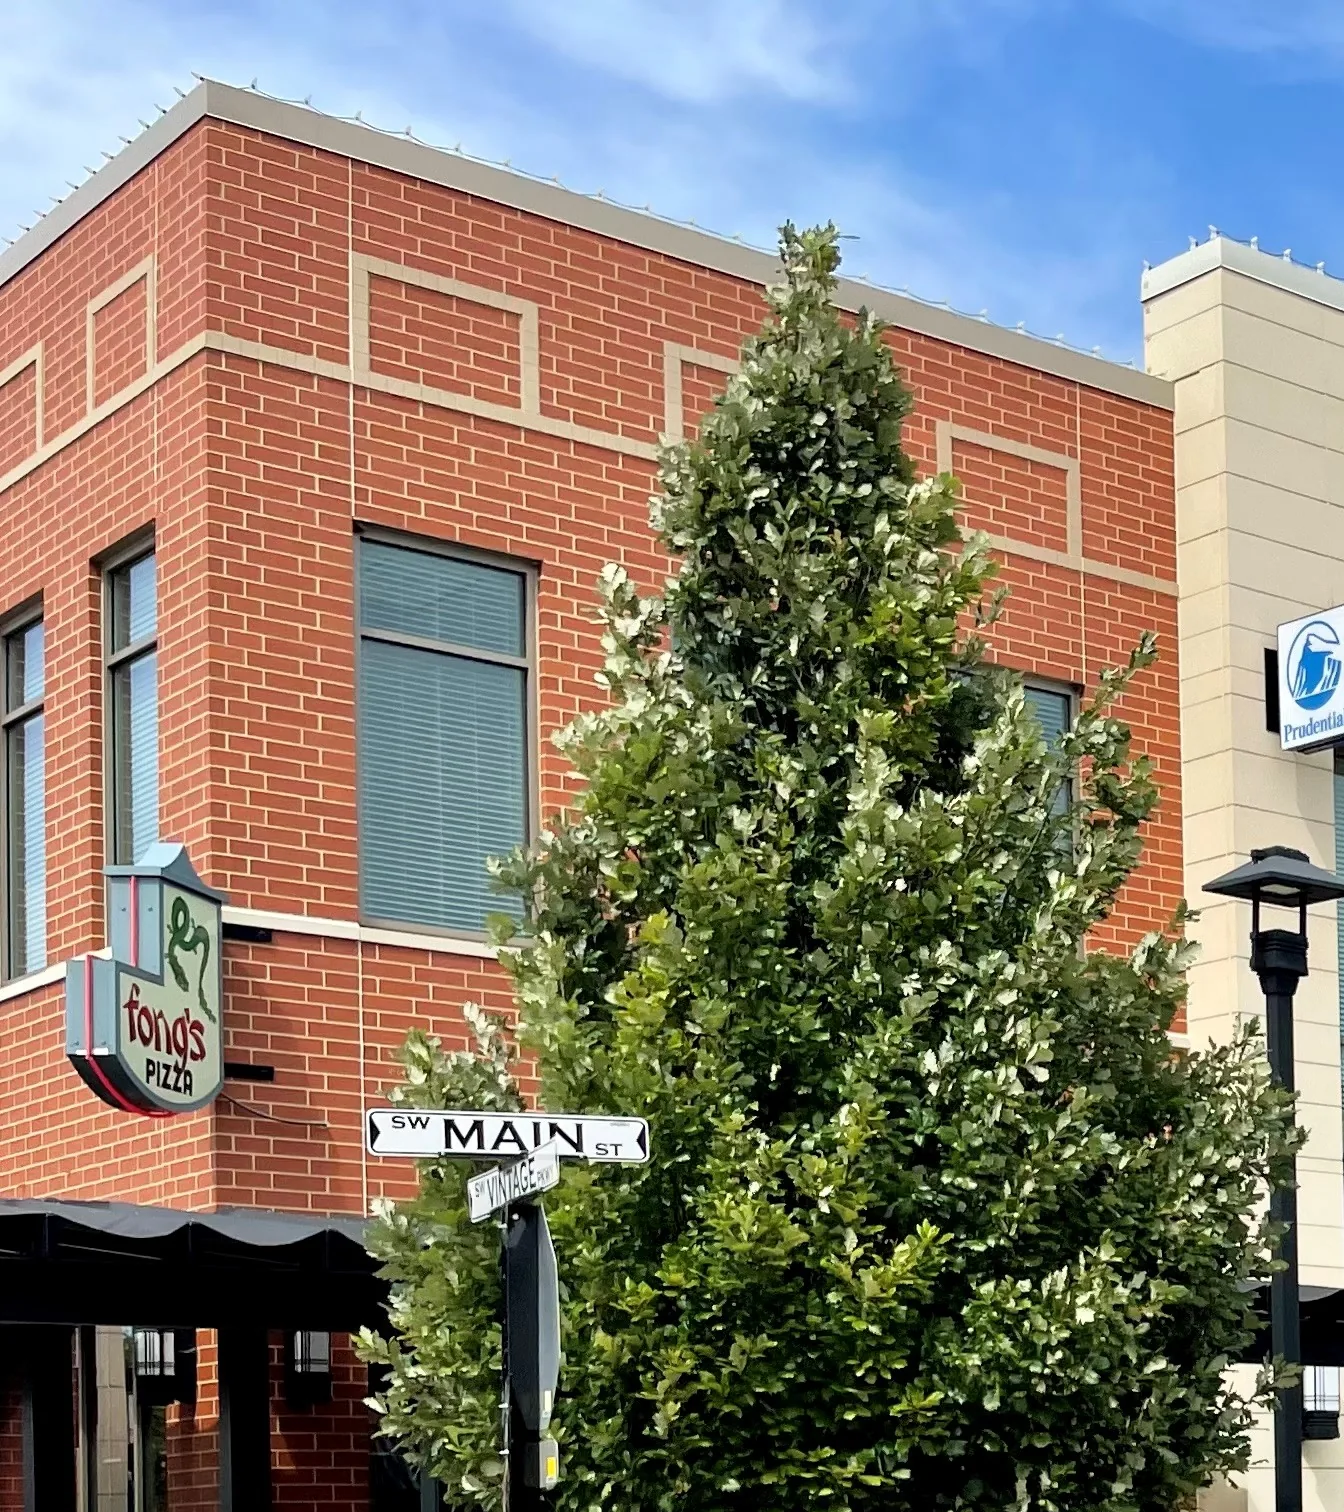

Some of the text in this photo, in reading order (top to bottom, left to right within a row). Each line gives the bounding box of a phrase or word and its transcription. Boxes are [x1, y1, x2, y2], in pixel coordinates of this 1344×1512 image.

[123, 982, 207, 1072] fong's
[145, 1057, 194, 1097] PIZZA
[391, 1115, 623, 1157] SW MAIN ST
[486, 1156, 537, 1208] VINTAGE
